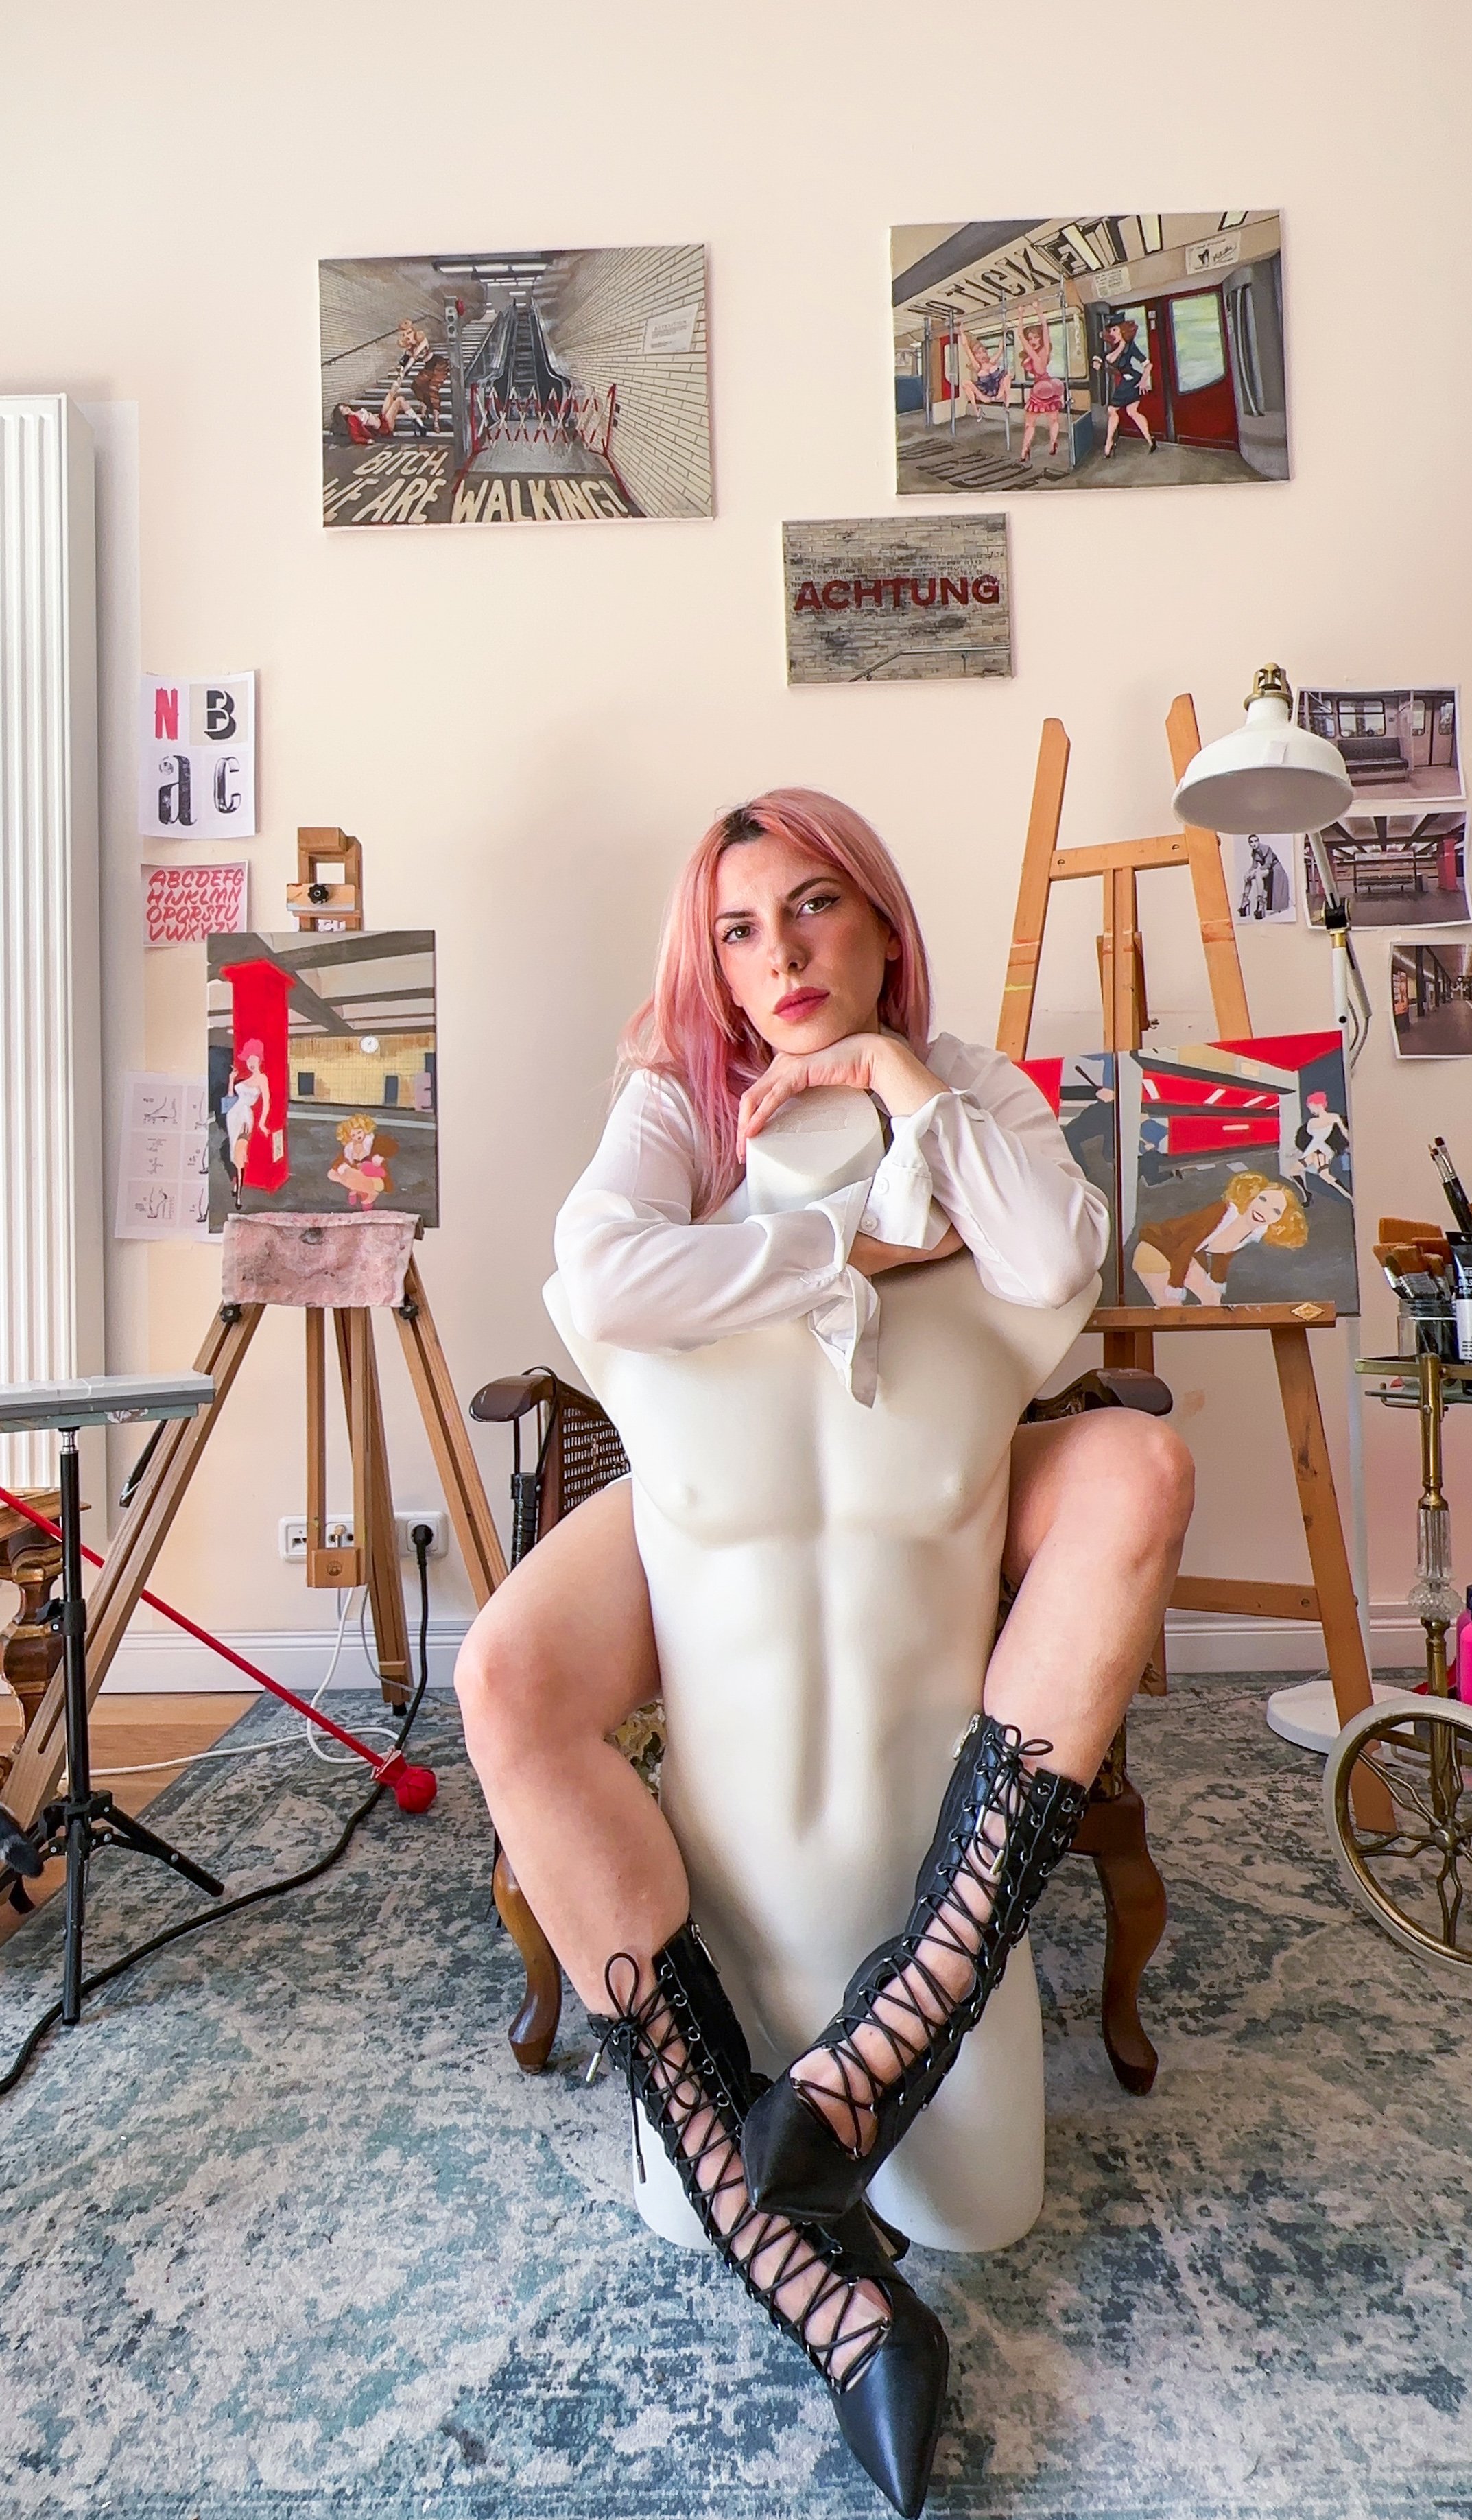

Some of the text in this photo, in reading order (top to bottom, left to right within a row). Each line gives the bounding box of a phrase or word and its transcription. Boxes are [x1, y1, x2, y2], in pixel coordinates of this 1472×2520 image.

[351, 478, 446, 523] ARE
[451, 479, 628, 523] WALKING!
[794, 574, 1000, 611] ACHTUNG
[154, 687, 236, 740] N B
[149, 869, 244, 888] ABCDEFG
[147, 886, 241, 906] HIJKLMN
[147, 904, 239, 925] OPQRSTU
